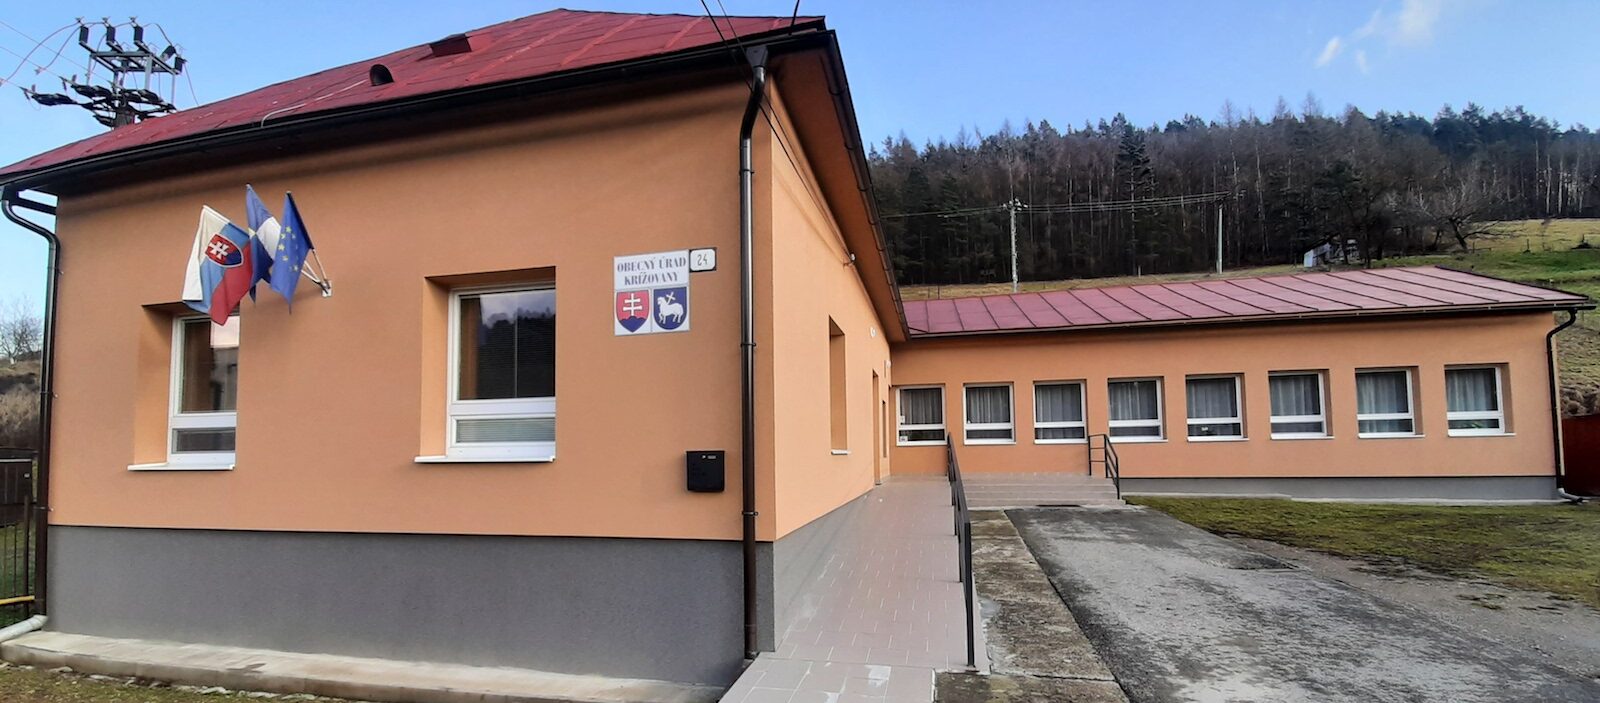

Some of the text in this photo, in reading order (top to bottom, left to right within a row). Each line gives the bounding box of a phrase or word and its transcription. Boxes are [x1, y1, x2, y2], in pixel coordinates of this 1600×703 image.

[617, 256, 686, 272] OBECNÝ ÚRAD
[697, 254, 708, 266] 24
[624, 271, 678, 285] KRÍŽOVANY
